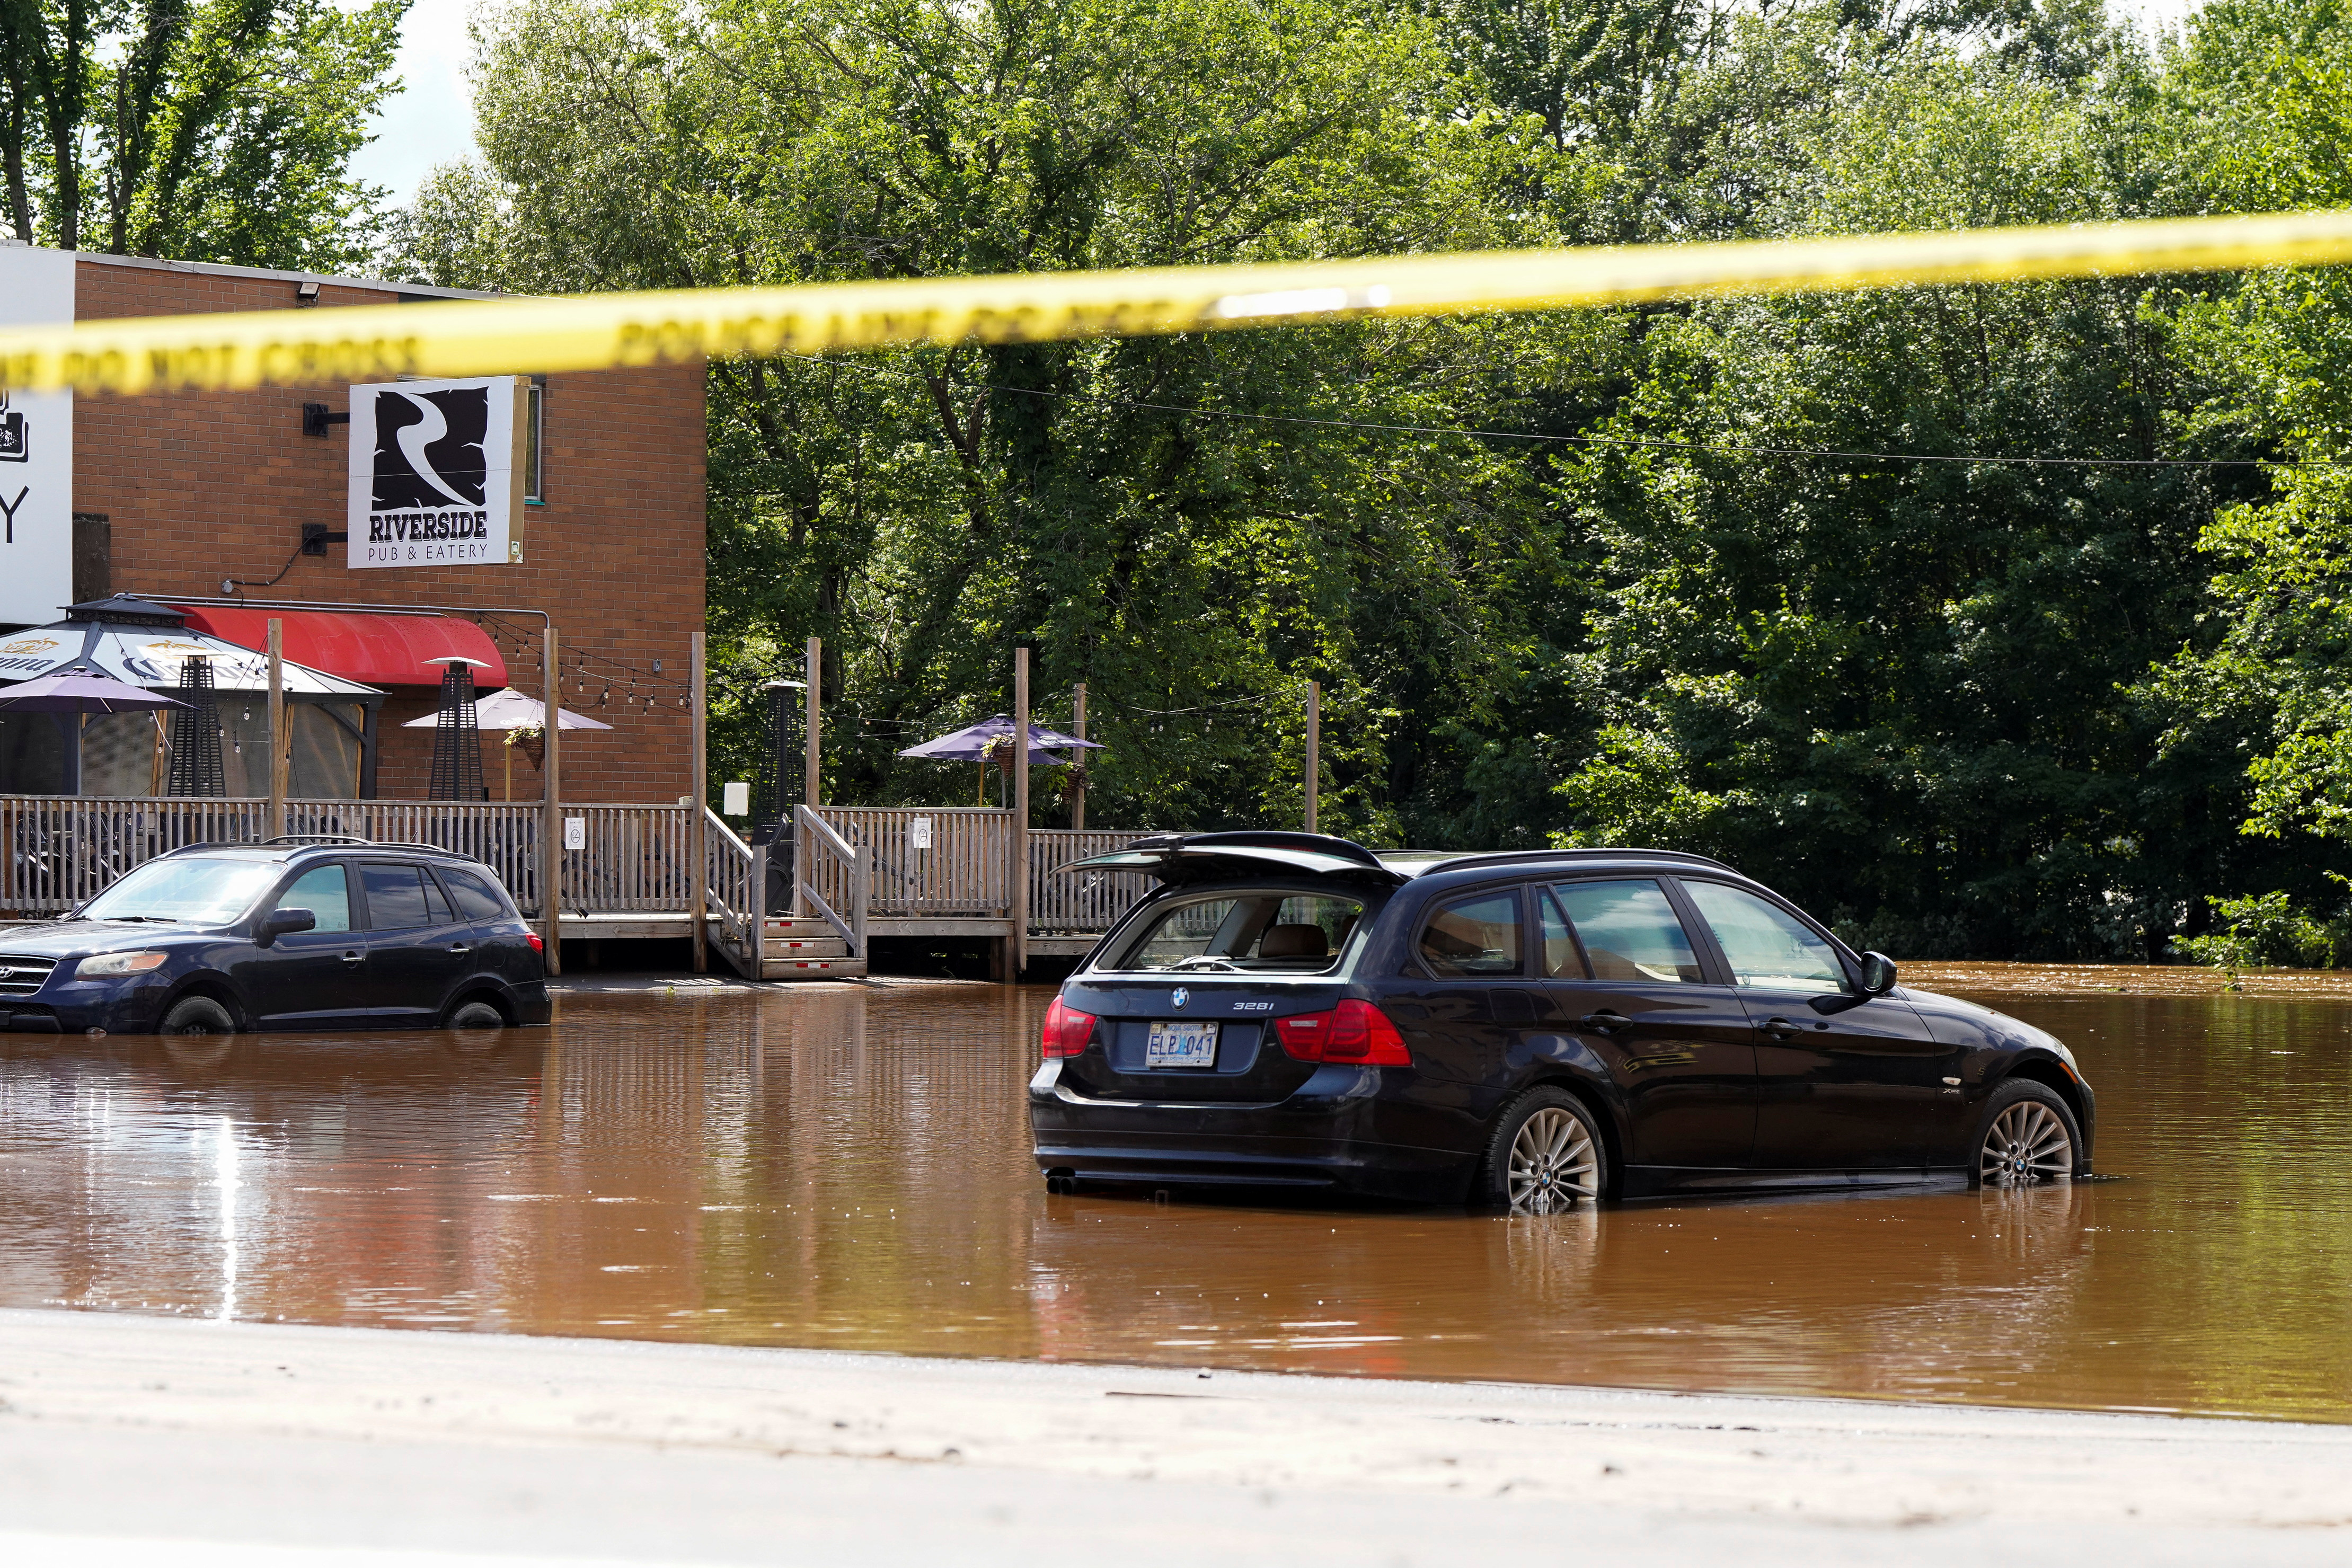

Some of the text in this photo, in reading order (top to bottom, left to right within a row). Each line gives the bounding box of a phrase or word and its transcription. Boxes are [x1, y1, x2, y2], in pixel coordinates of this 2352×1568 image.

[369, 511, 488, 543] RIVERSIDE
[369, 544, 488, 561] PUB & EATERY
